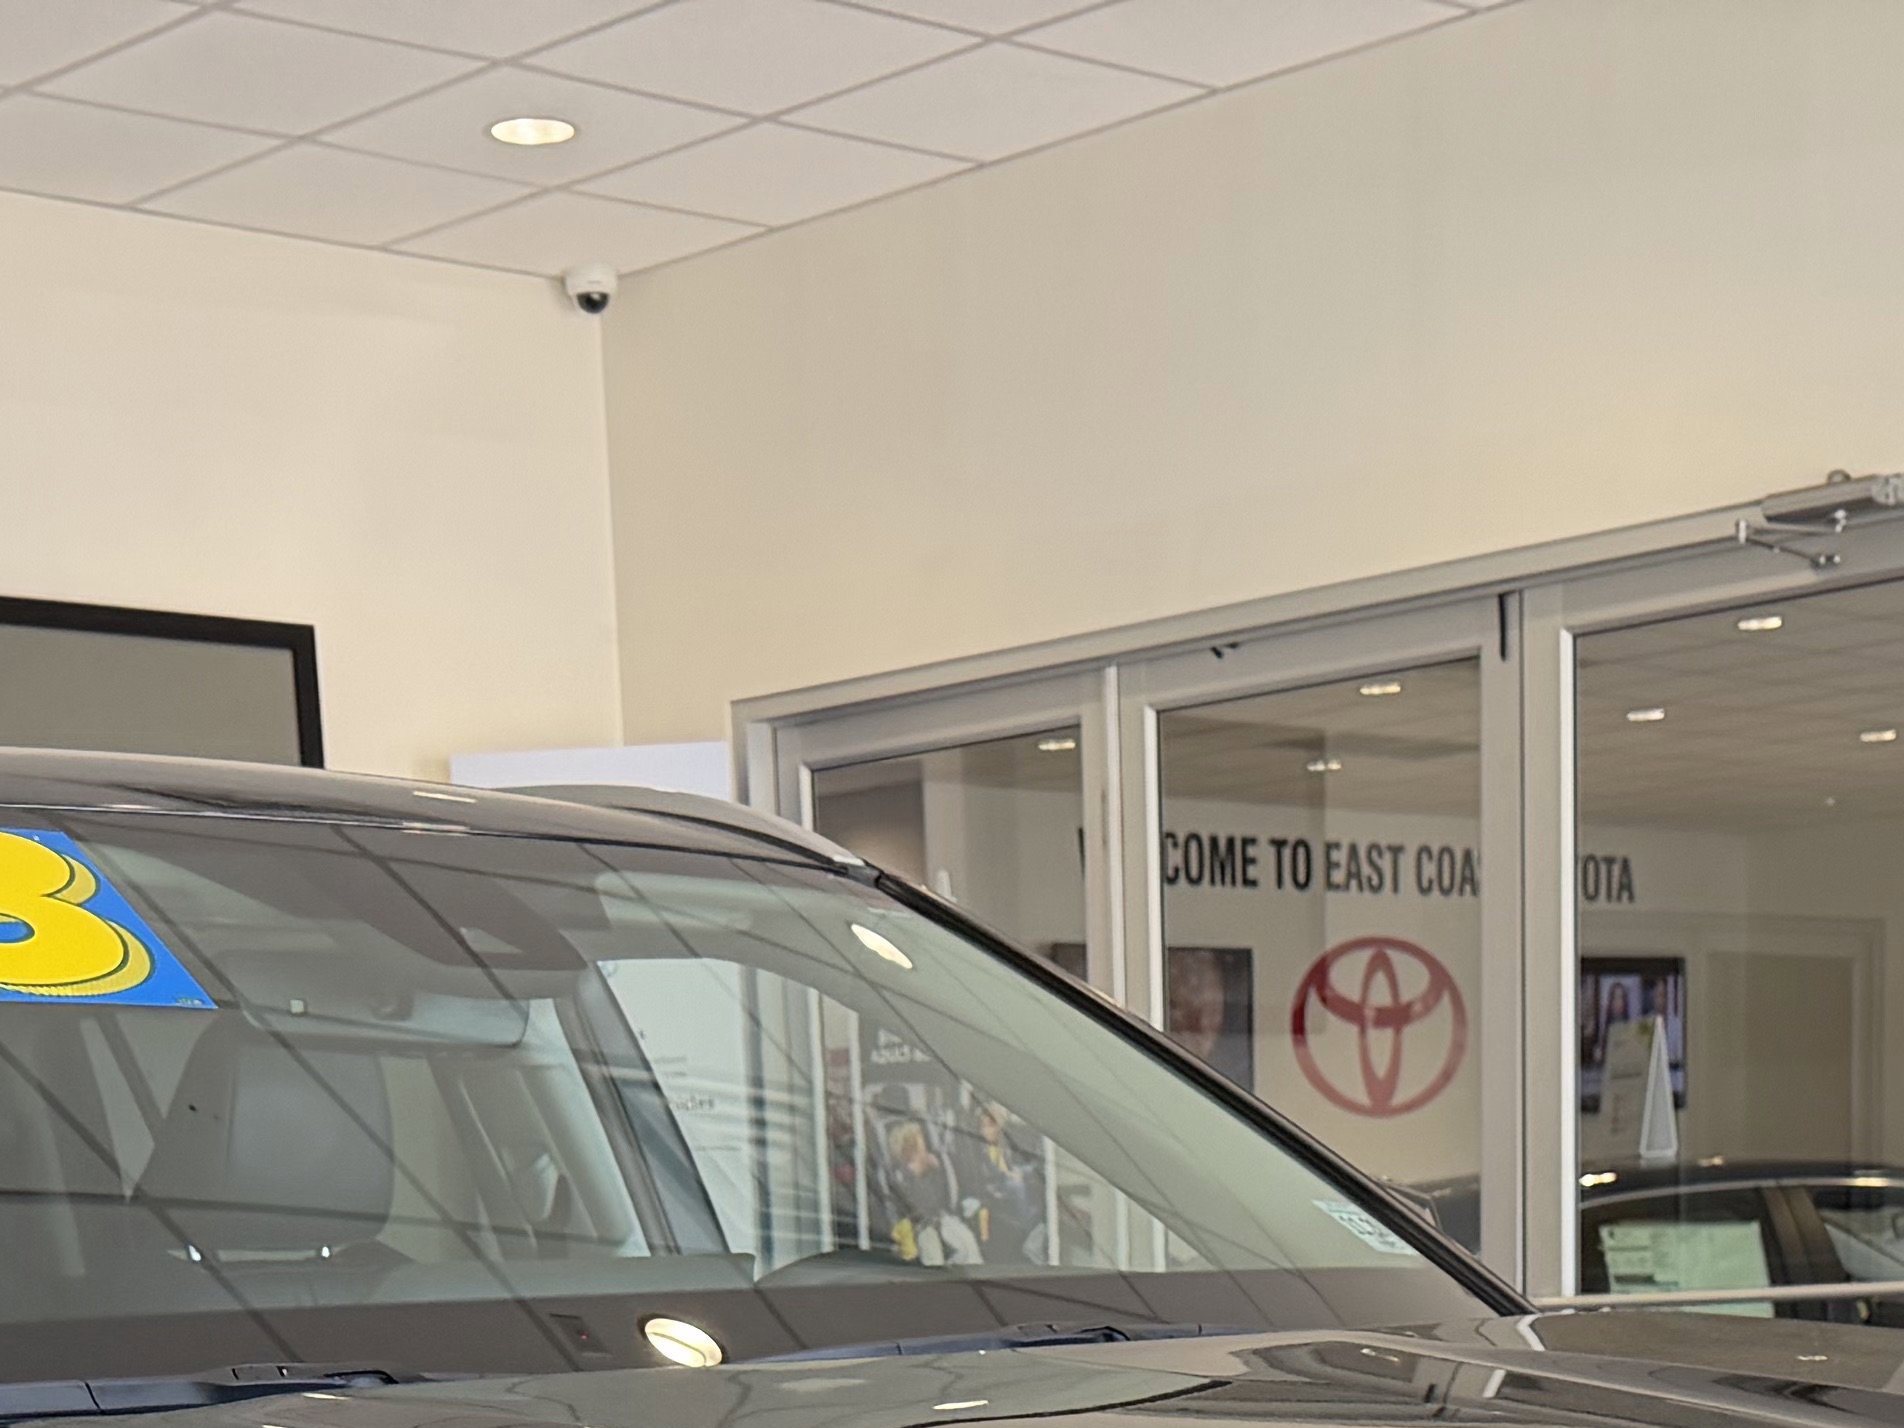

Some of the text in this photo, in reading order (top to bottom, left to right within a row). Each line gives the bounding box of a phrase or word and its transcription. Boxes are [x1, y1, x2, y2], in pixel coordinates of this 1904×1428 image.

[1268, 838, 1312, 890] TO
[1324, 840, 1405, 895] EAST
[1415, 844, 1481, 897] COA
